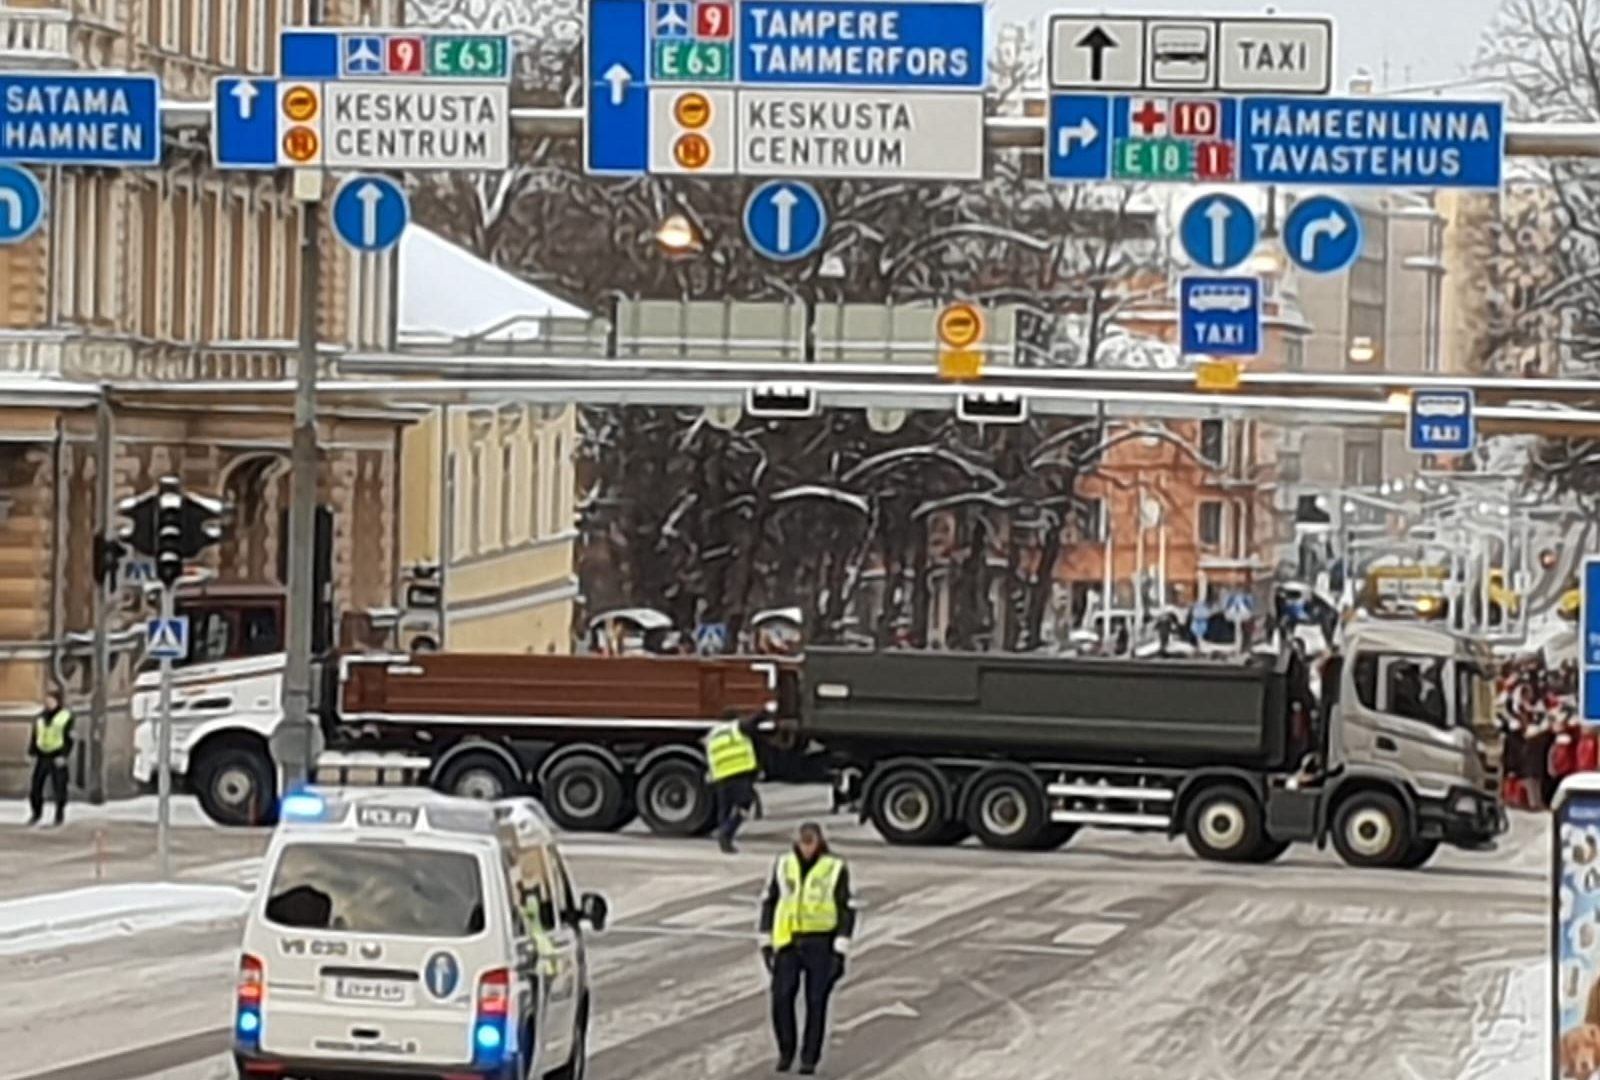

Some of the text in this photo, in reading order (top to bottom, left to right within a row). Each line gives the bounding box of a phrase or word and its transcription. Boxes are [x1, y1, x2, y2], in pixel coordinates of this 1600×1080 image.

[705, 6, 721, 35] 9
[750, 9, 899, 40] TAMPERE
[397, 41, 414, 71] 9
[750, 43, 969, 76] TAMMERFORS
[1239, 41, 1306, 70] TAXI
[6, 84, 130, 115] SATAMA
[336, 94, 495, 123] KESKUSTA
[748, 102, 910, 131] KESKUSTA
[1181, 105, 1212, 132] 10
[1251, 108, 1490, 140] HÄMEENLINNA
[5, 121, 142, 151] HAMNEN
[336, 129, 487, 157] CENTRUM
[748, 137, 903, 165] CENTRUM
[1208, 146, 1218, 174] 1
[1250, 146, 1461, 176] TAVASTEHUS
[1196, 324, 1243, 345] TAXI
[1421, 425, 1461, 442] TAXI
